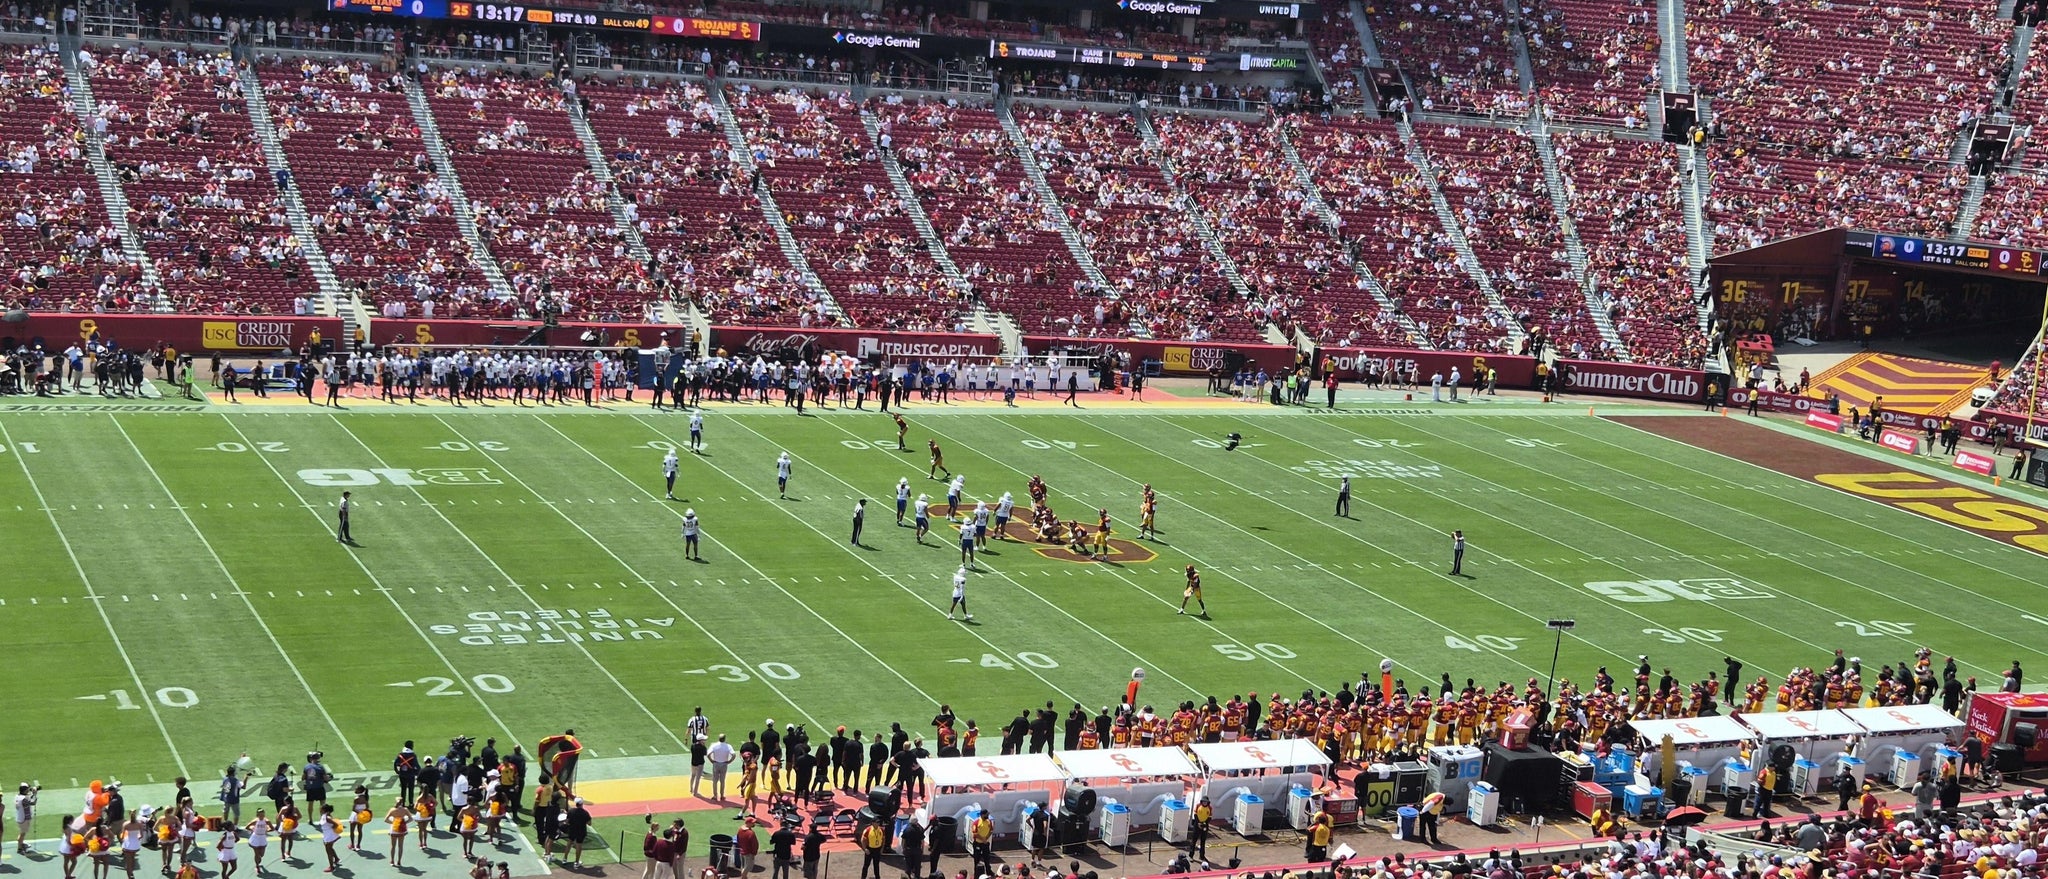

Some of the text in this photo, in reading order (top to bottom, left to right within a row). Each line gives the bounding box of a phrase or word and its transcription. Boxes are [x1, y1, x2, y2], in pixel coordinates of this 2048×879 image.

[411, 0, 424, 14] 0
[452, 5, 469, 16] 25
[475, 4, 524, 21] 13:17
[1129, 0, 1201, 15] Google Gemini
[1259, 5, 1290, 15] UNITED
[554, 12, 597, 25] 1ST & 10
[603, 18, 650, 29] BALL ON 49
[692, 19, 737, 31] TROJANS
[673, 18, 684, 33] 0
[846, 33, 921, 49] Google Gemini
[1015, 47, 1057, 59] TROJANS
[1123, 58, 1136, 67] 20
[1191, 63, 1203, 71] 28
[1903, 240, 1915, 253] 0
[1926, 243, 1965, 257] 13:17
[2000, 250, 2011, 264] 0
[1978, 261, 1989, 269] 49
[1721, 280, 1746, 302] 36
[1782, 281, 1801, 304] 11
[204, 328, 235, 341] USC
[238, 322, 296, 334] CREDIT
[238, 334, 292, 346] UNION
[1165, 352, 1190, 364] USC
[1191, 358, 1225, 370] UNIO
[1565, 364, 1699, 397] SummerClub
[216, 441, 290, 453] 20
[439, 441, 510, 451] 30
[840, 440, 900, 450] 50
[1021, 439, 1077, 449] 40
[1352, 438, 1415, 448] 20
[467, 608, 612, 621] FIELD
[430, 617, 676, 634] AIRLINES
[1834, 620, 1914, 636] 20
[459, 630, 664, 645] UNITED
[1642, 627, 1724, 643] 30
[1443, 634, 1520, 652] 40
[1211, 643, 1298, 661] 50
[980, 651, 1060, 671] 40
[708, 662, 801, 683] 30
[416, 673, 516, 697] 20
[109, 687, 200, 710] 10
[1142, 720, 1154, 730] 61
[1227, 715, 1239, 727] 65
[1082, 737, 1096, 748] 53
[1115, 732, 1126, 743] 81
[1367, 788, 1392, 808] 00
